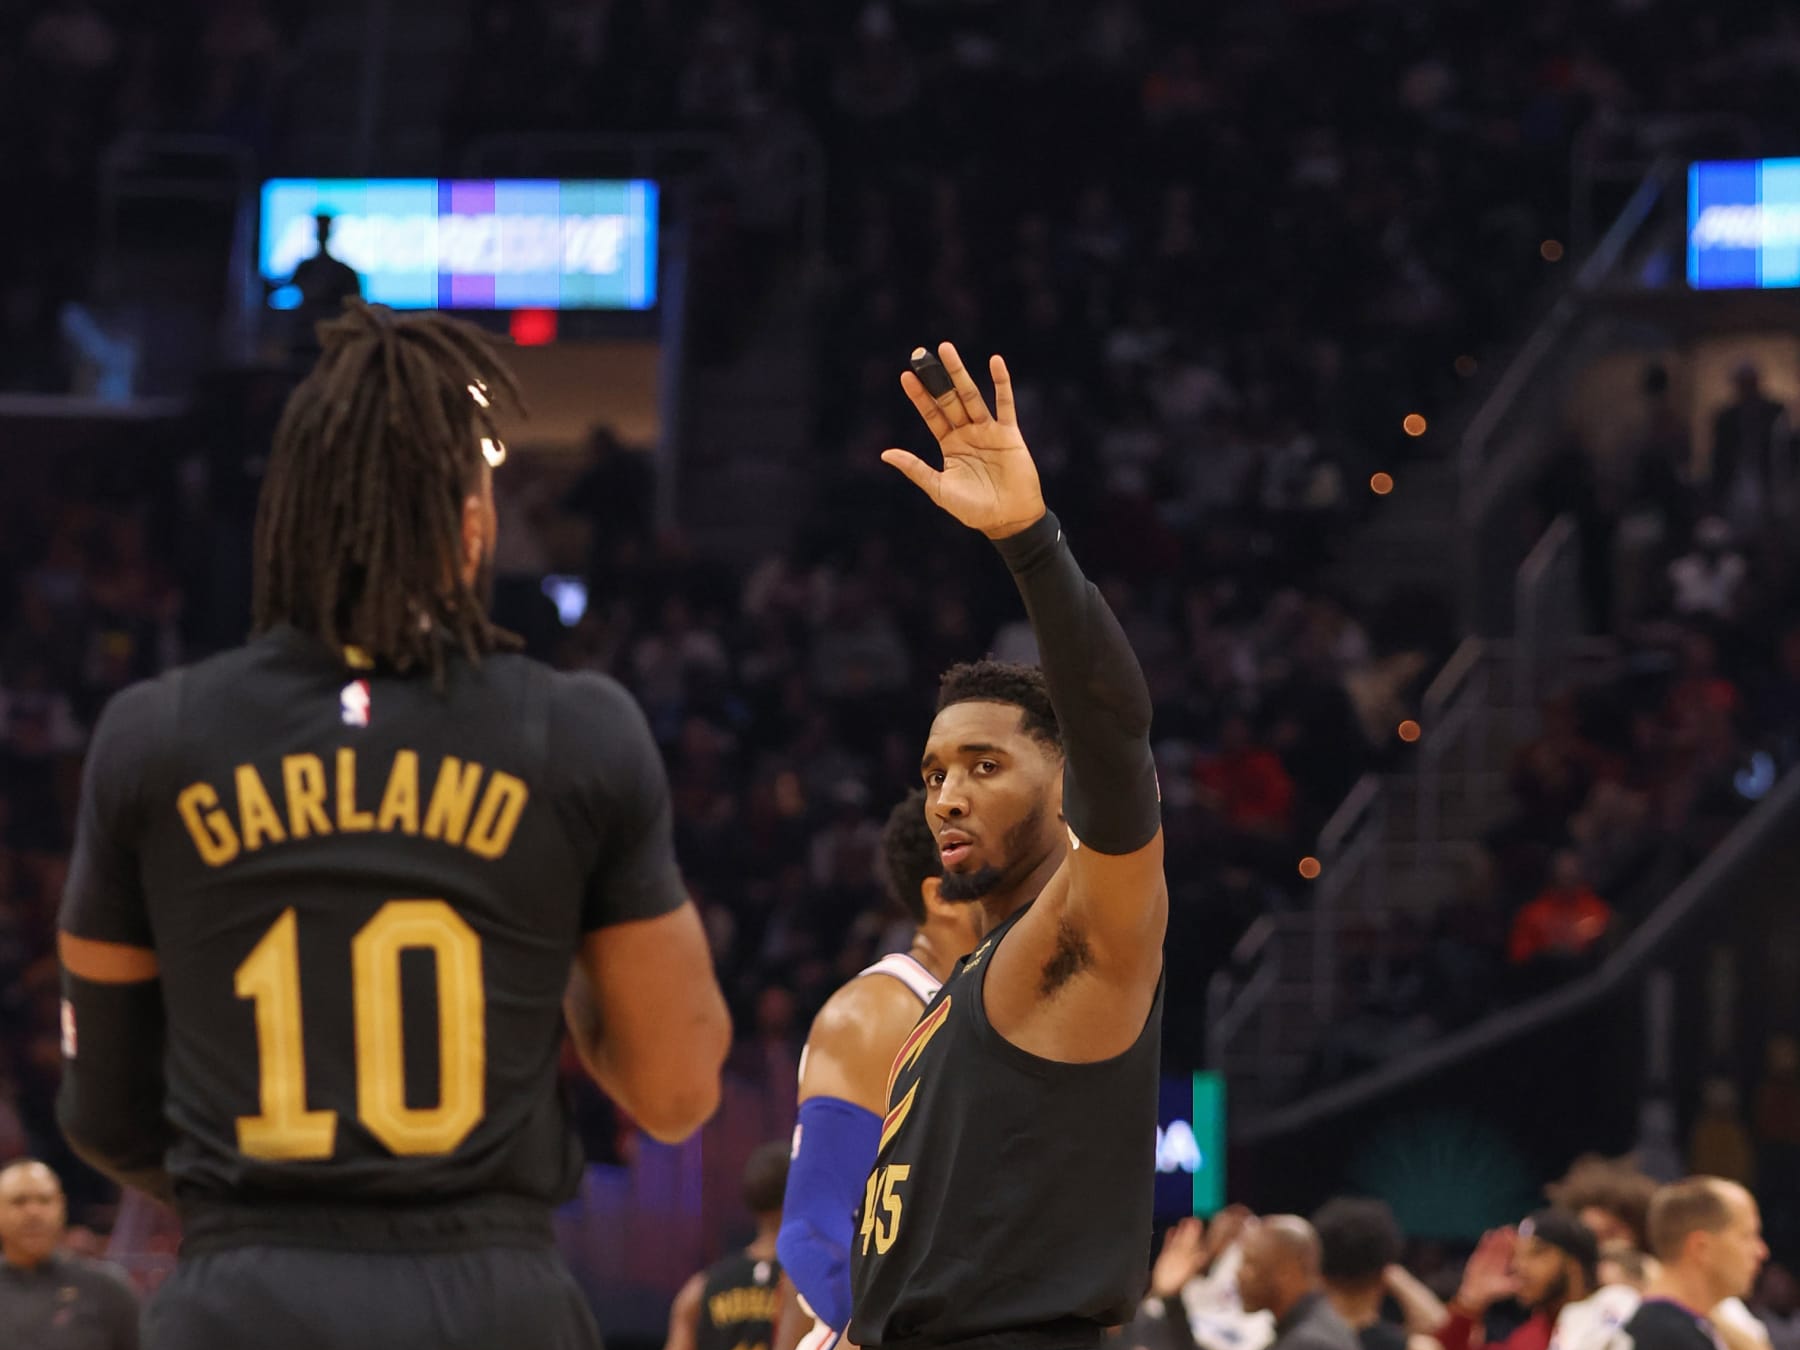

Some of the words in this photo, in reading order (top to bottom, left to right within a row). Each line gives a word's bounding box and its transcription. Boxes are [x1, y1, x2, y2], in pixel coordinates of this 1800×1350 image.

[176, 747, 529, 868] GARLAND
[233, 898, 486, 1162] 10
[860, 1164, 911, 1256] 45
